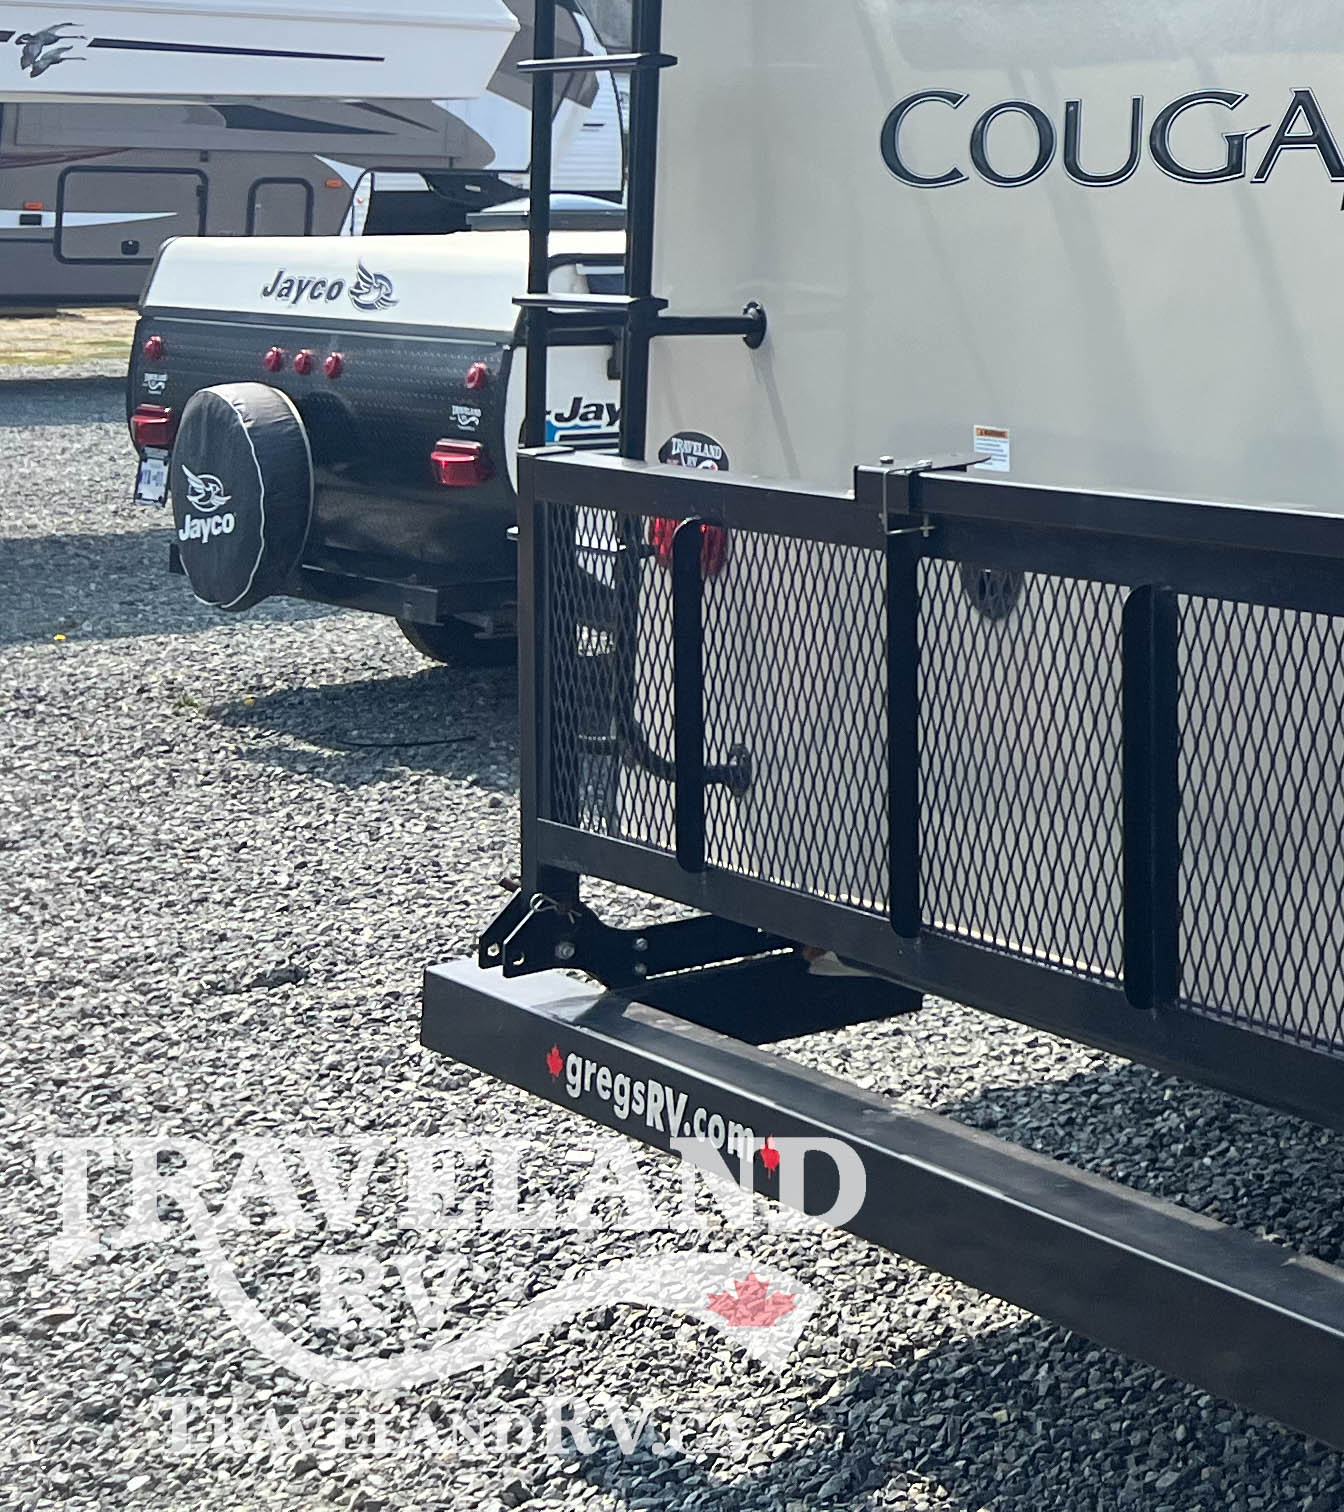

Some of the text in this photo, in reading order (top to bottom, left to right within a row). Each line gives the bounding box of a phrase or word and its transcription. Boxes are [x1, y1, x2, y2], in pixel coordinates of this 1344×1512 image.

[261, 269, 346, 306] Jayco
[179, 513, 235, 544] Jayco
[565, 1052, 755, 1163] gregsRV.com
